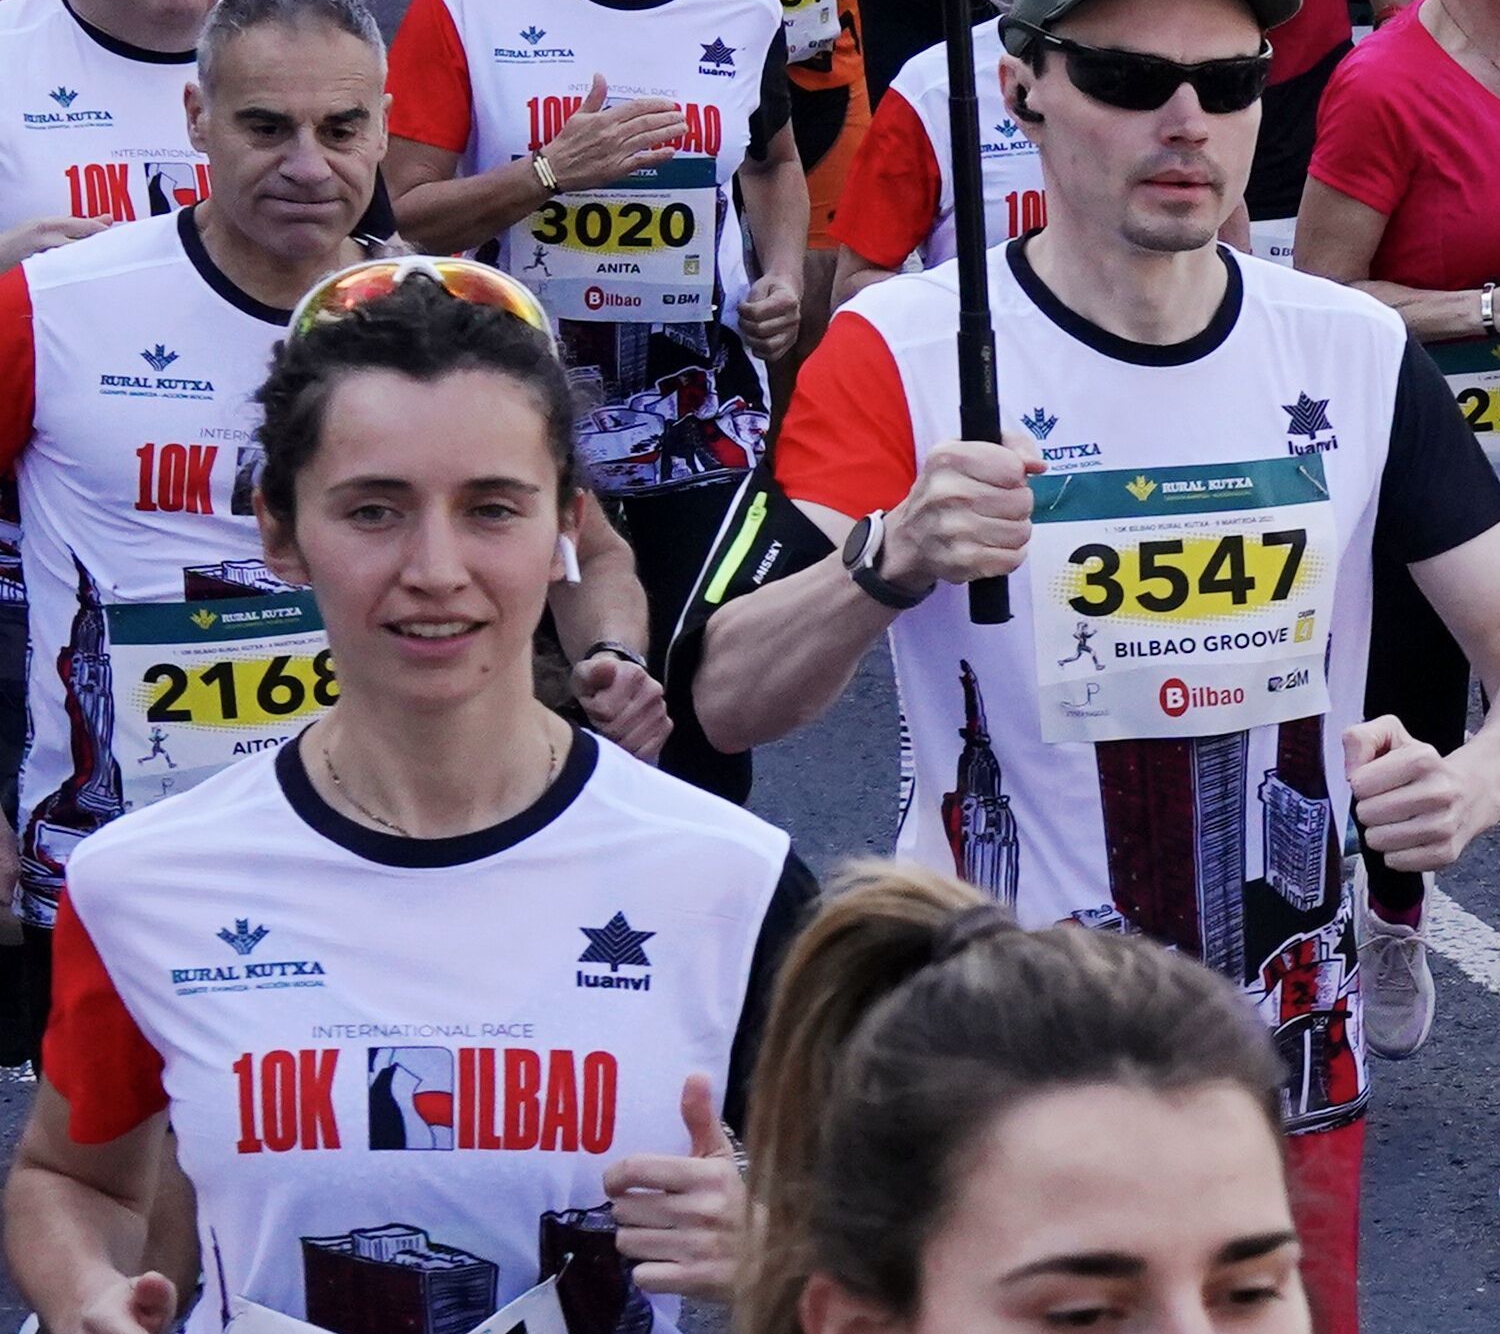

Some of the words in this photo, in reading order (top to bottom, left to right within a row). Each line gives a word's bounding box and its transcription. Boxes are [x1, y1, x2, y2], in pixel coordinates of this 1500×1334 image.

[536, 46, 575, 59] KUTXA
[23, 111, 68, 125] RURAL
[69, 110, 113, 124] KUTXA
[65, 164, 130, 222] 10K
[533, 199, 696, 249] 3020
[596, 262, 641, 274] ANITA
[584, 285, 642, 311] Bilbao
[677, 293, 701, 305] BM
[100, 373, 155, 391] RURAL
[158, 376, 214, 394] KUTXA
[136, 443, 218, 513] 10K
[1162, 479, 1204, 495] RURAL
[1208, 475, 1253, 492] KUTXA
[1067, 529, 1308, 618] 3547
[1114, 637, 1197, 658] BILBAO
[1202, 626, 1289, 654] GROOVE
[1161, 679, 1245, 715] Bilbao
[171, 968, 241, 985] RURAL
[245, 960, 325, 981] KUTXA
[576, 971, 651, 992] luanvi
[311, 1023, 477, 1039] INTERNATIONAL
[481, 1022, 535, 1039] RACE
[232, 1048, 342, 1155] 10K
